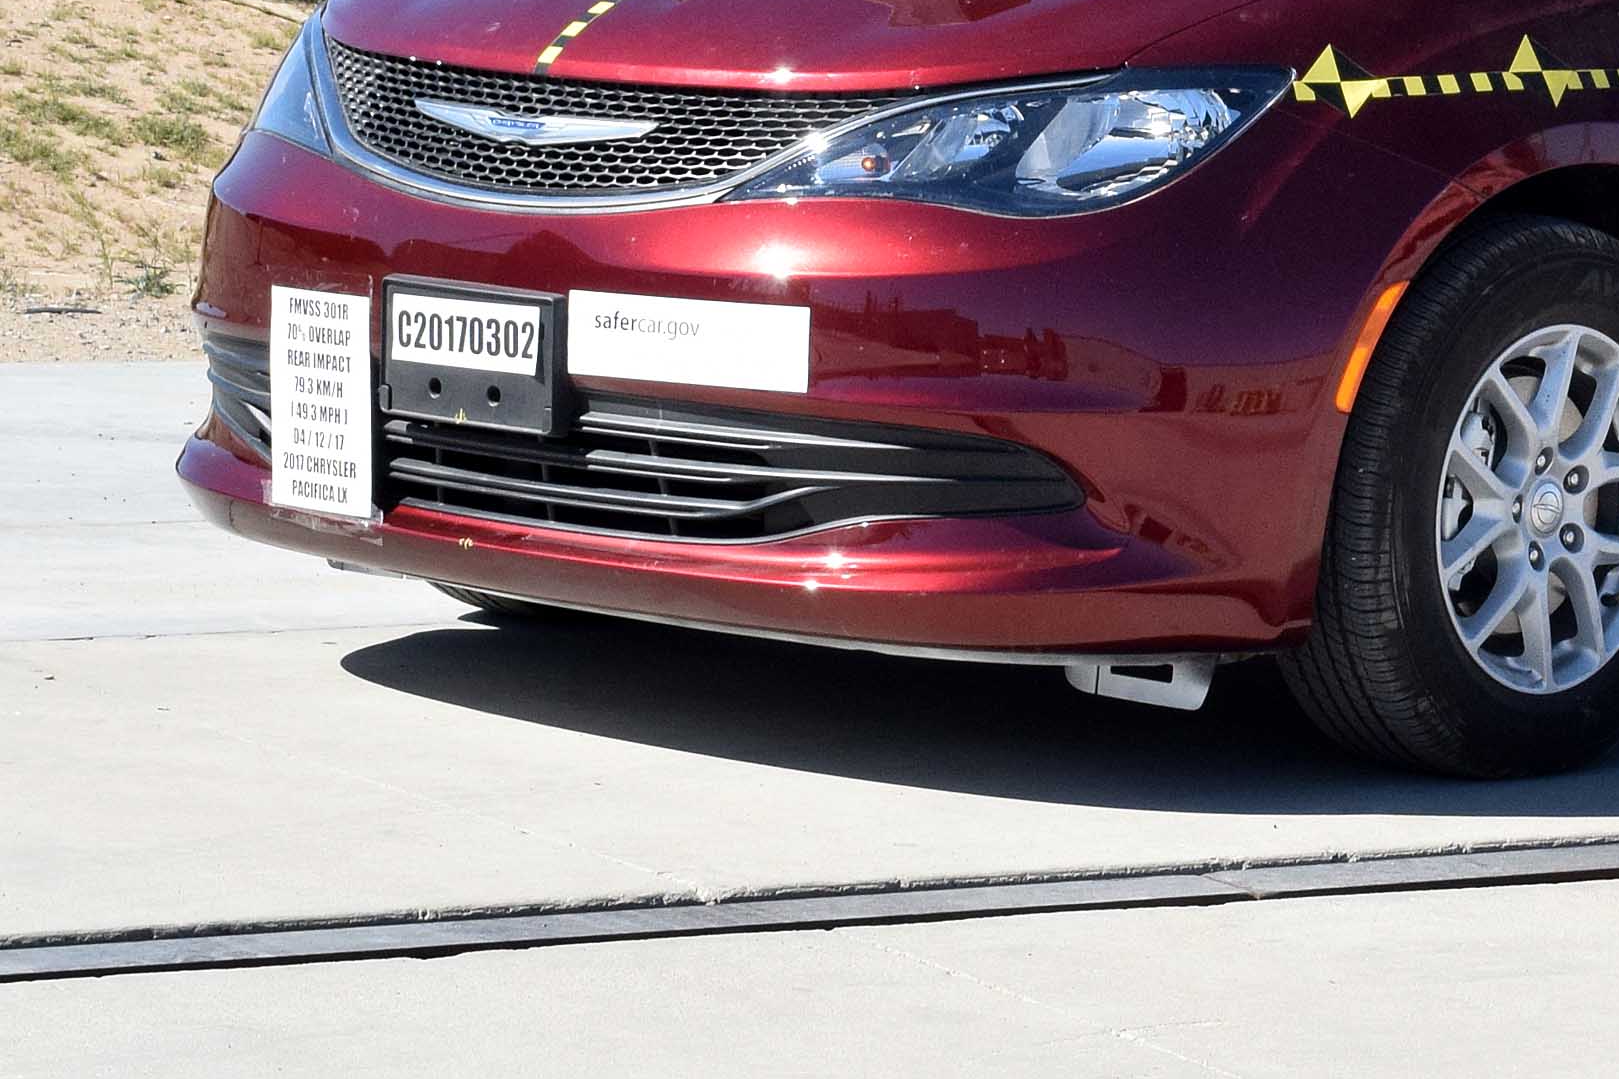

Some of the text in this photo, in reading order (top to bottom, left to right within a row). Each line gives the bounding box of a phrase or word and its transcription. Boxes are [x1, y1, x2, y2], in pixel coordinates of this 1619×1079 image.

[289, 297, 349, 320] FMVSS 301R
[308, 325, 351, 347] OVERLAP
[398, 310, 536, 360] C20170302
[594, 310, 701, 341] safercar.gov
[287, 349, 351, 374] REAR IMPACT
[294, 376, 343, 398] 793 KM/H
[283, 451, 357, 479] 2017 CHRYSLER
[292, 479, 348, 504] PACIFICA LX
